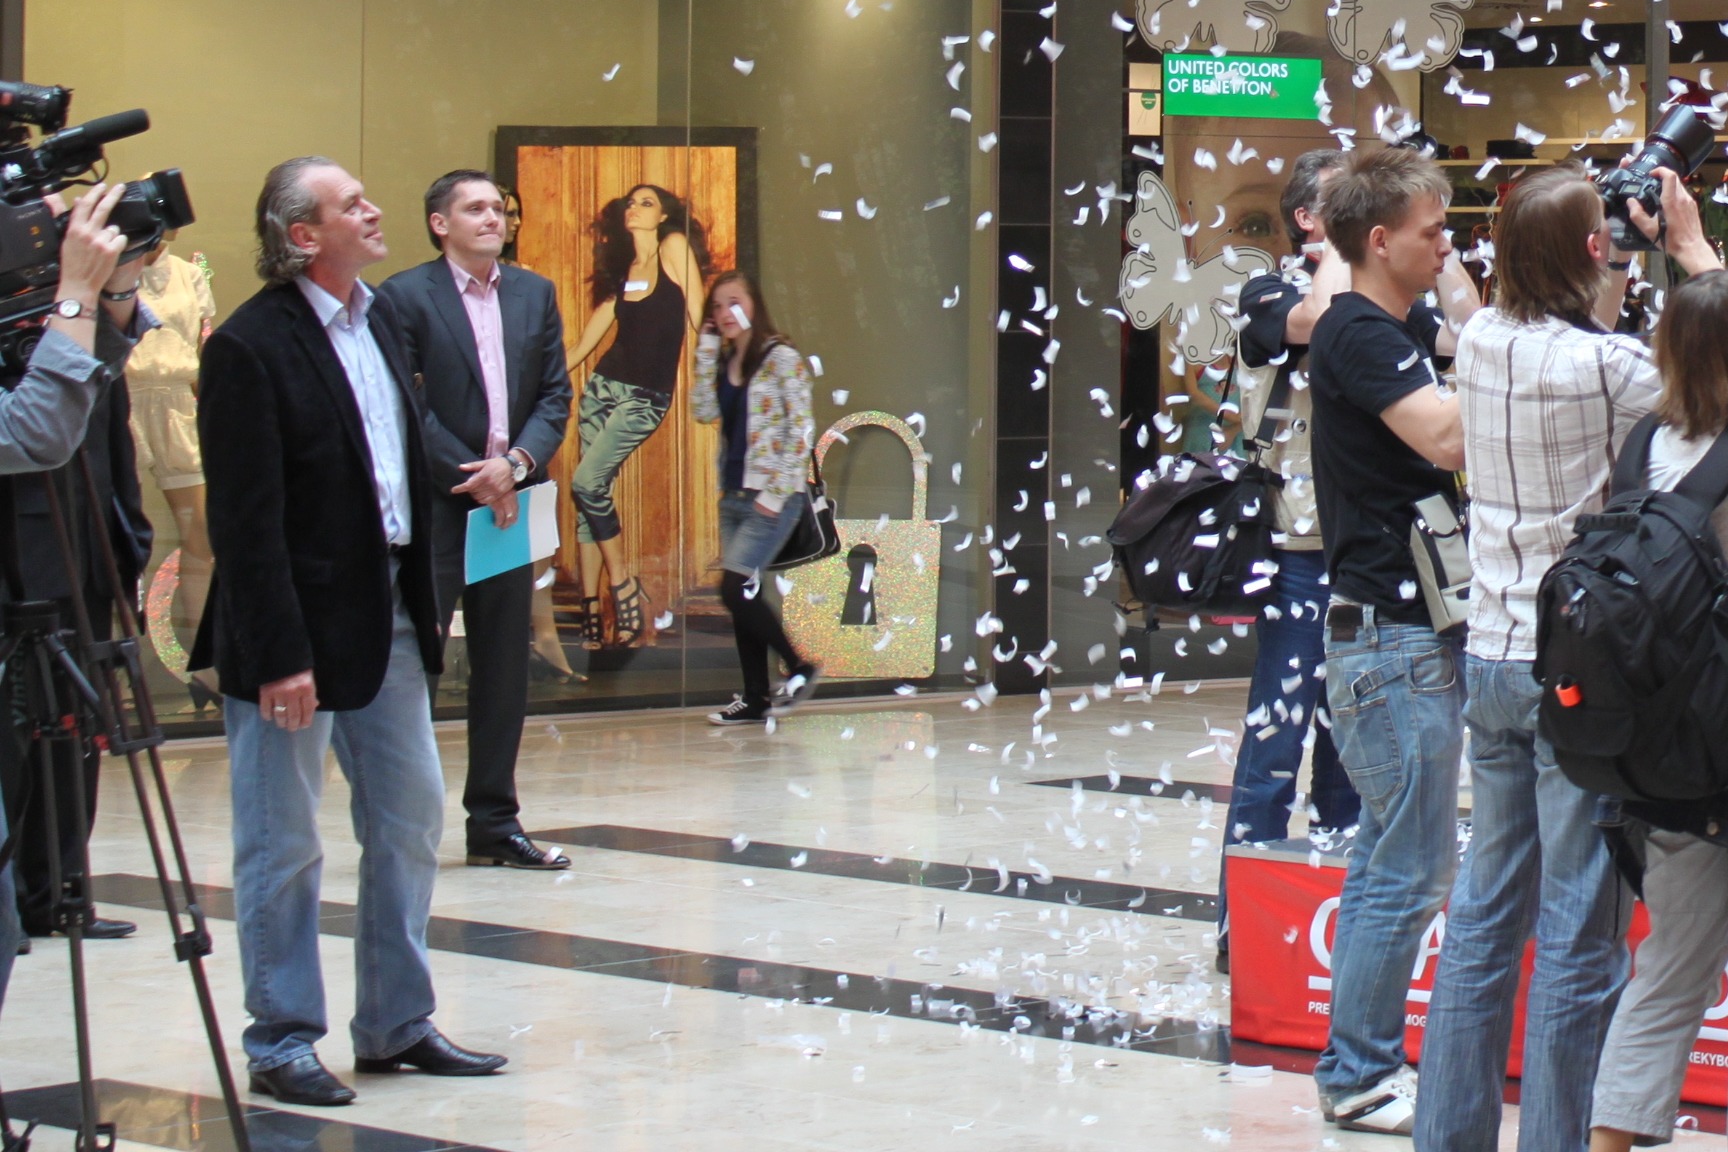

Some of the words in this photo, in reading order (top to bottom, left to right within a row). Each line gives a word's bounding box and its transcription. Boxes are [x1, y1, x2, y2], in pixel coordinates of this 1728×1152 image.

[1168, 60, 1225, 76] UNITED
[1228, 61, 1288, 78] COLORS
[1167, 78, 1190, 94] OF
